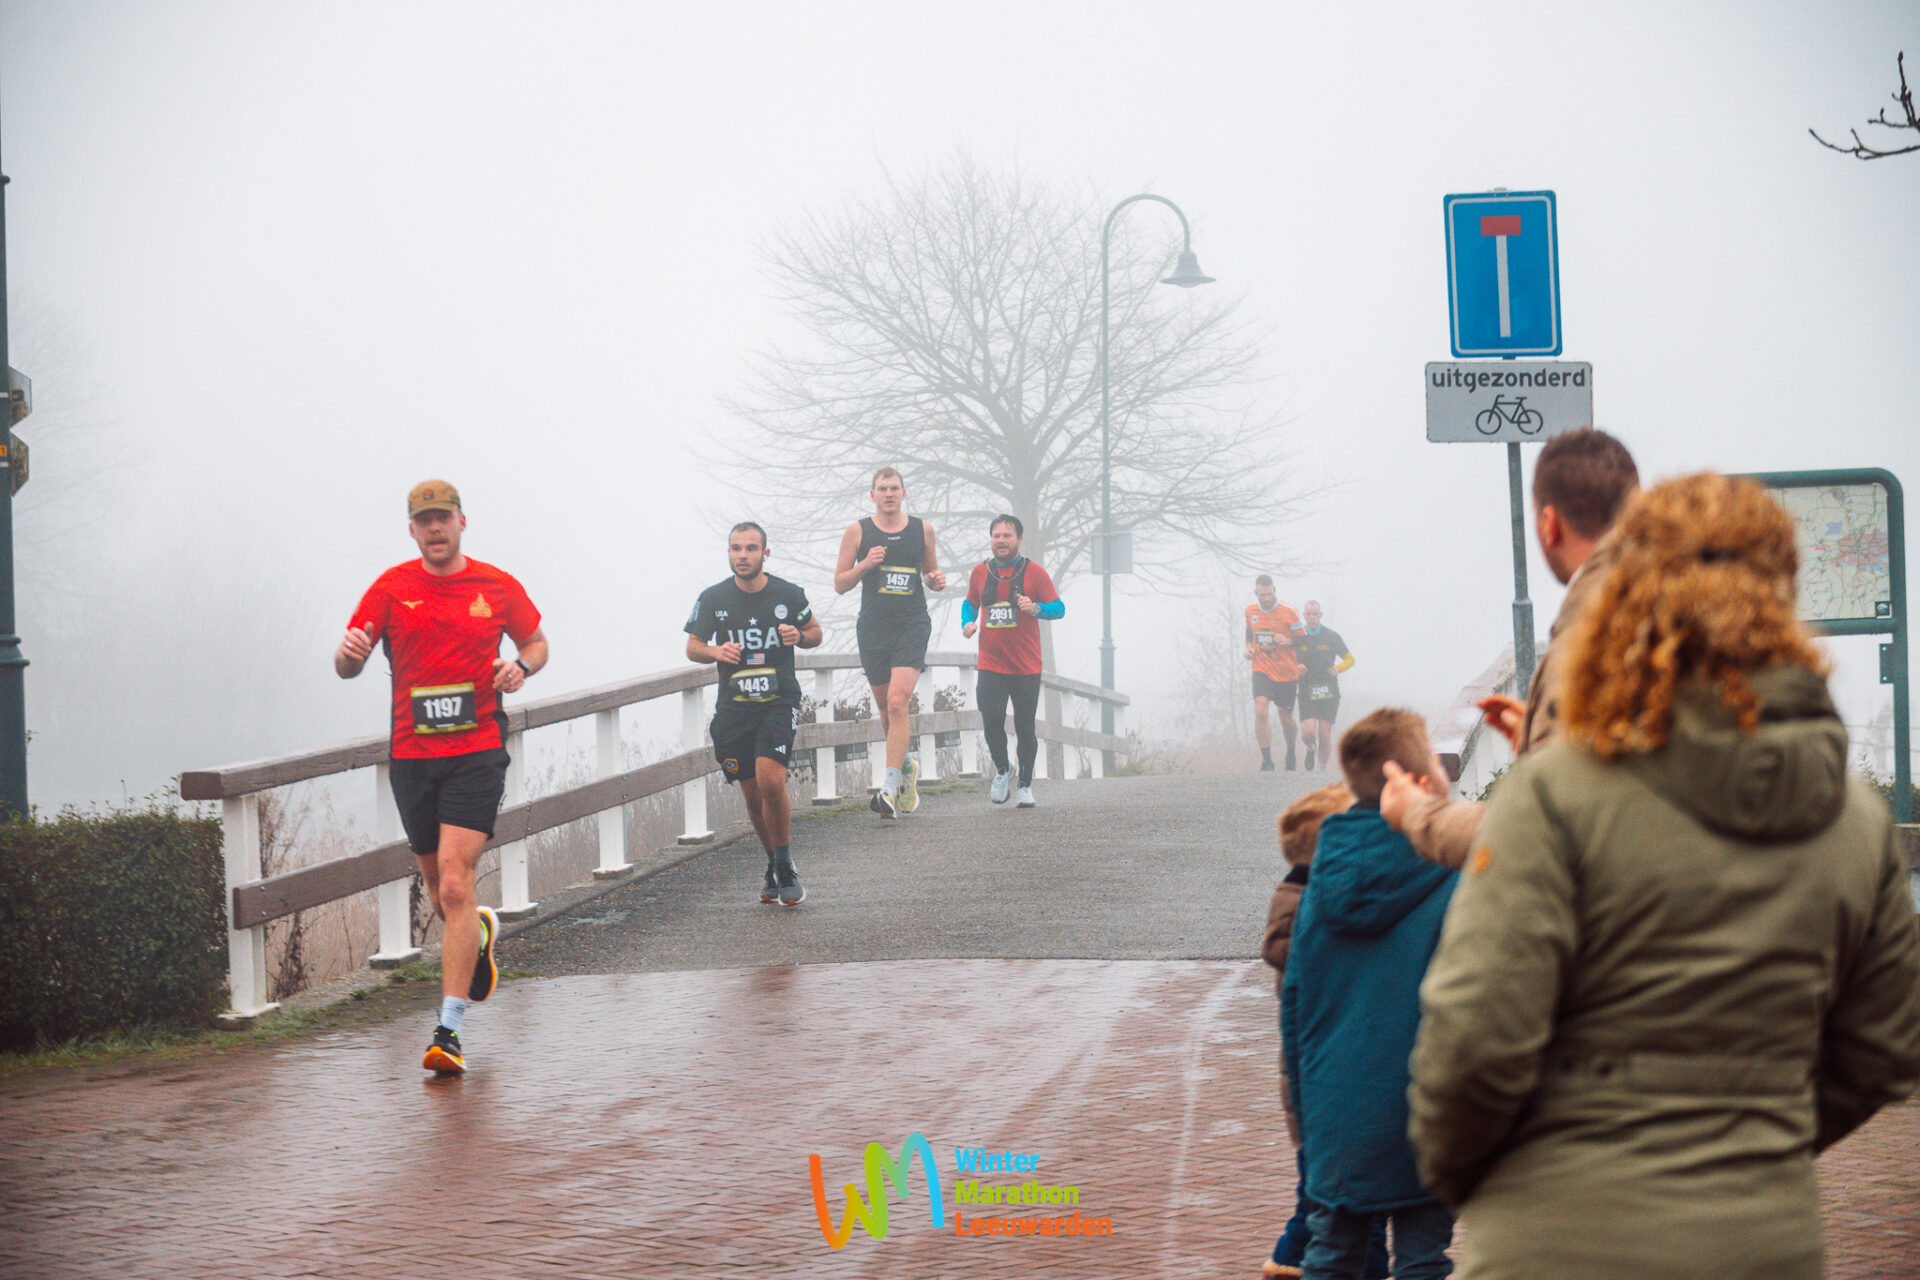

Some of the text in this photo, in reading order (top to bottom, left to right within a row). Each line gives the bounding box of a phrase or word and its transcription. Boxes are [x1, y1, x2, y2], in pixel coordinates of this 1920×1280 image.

[1432, 368, 1585, 393] uitgezonderd
[886, 573, 910, 586] 1457
[990, 608, 1012, 620] 2091
[728, 626, 780, 650] USA
[737, 677, 769, 692] 1443
[423, 696, 462, 719] 1197
